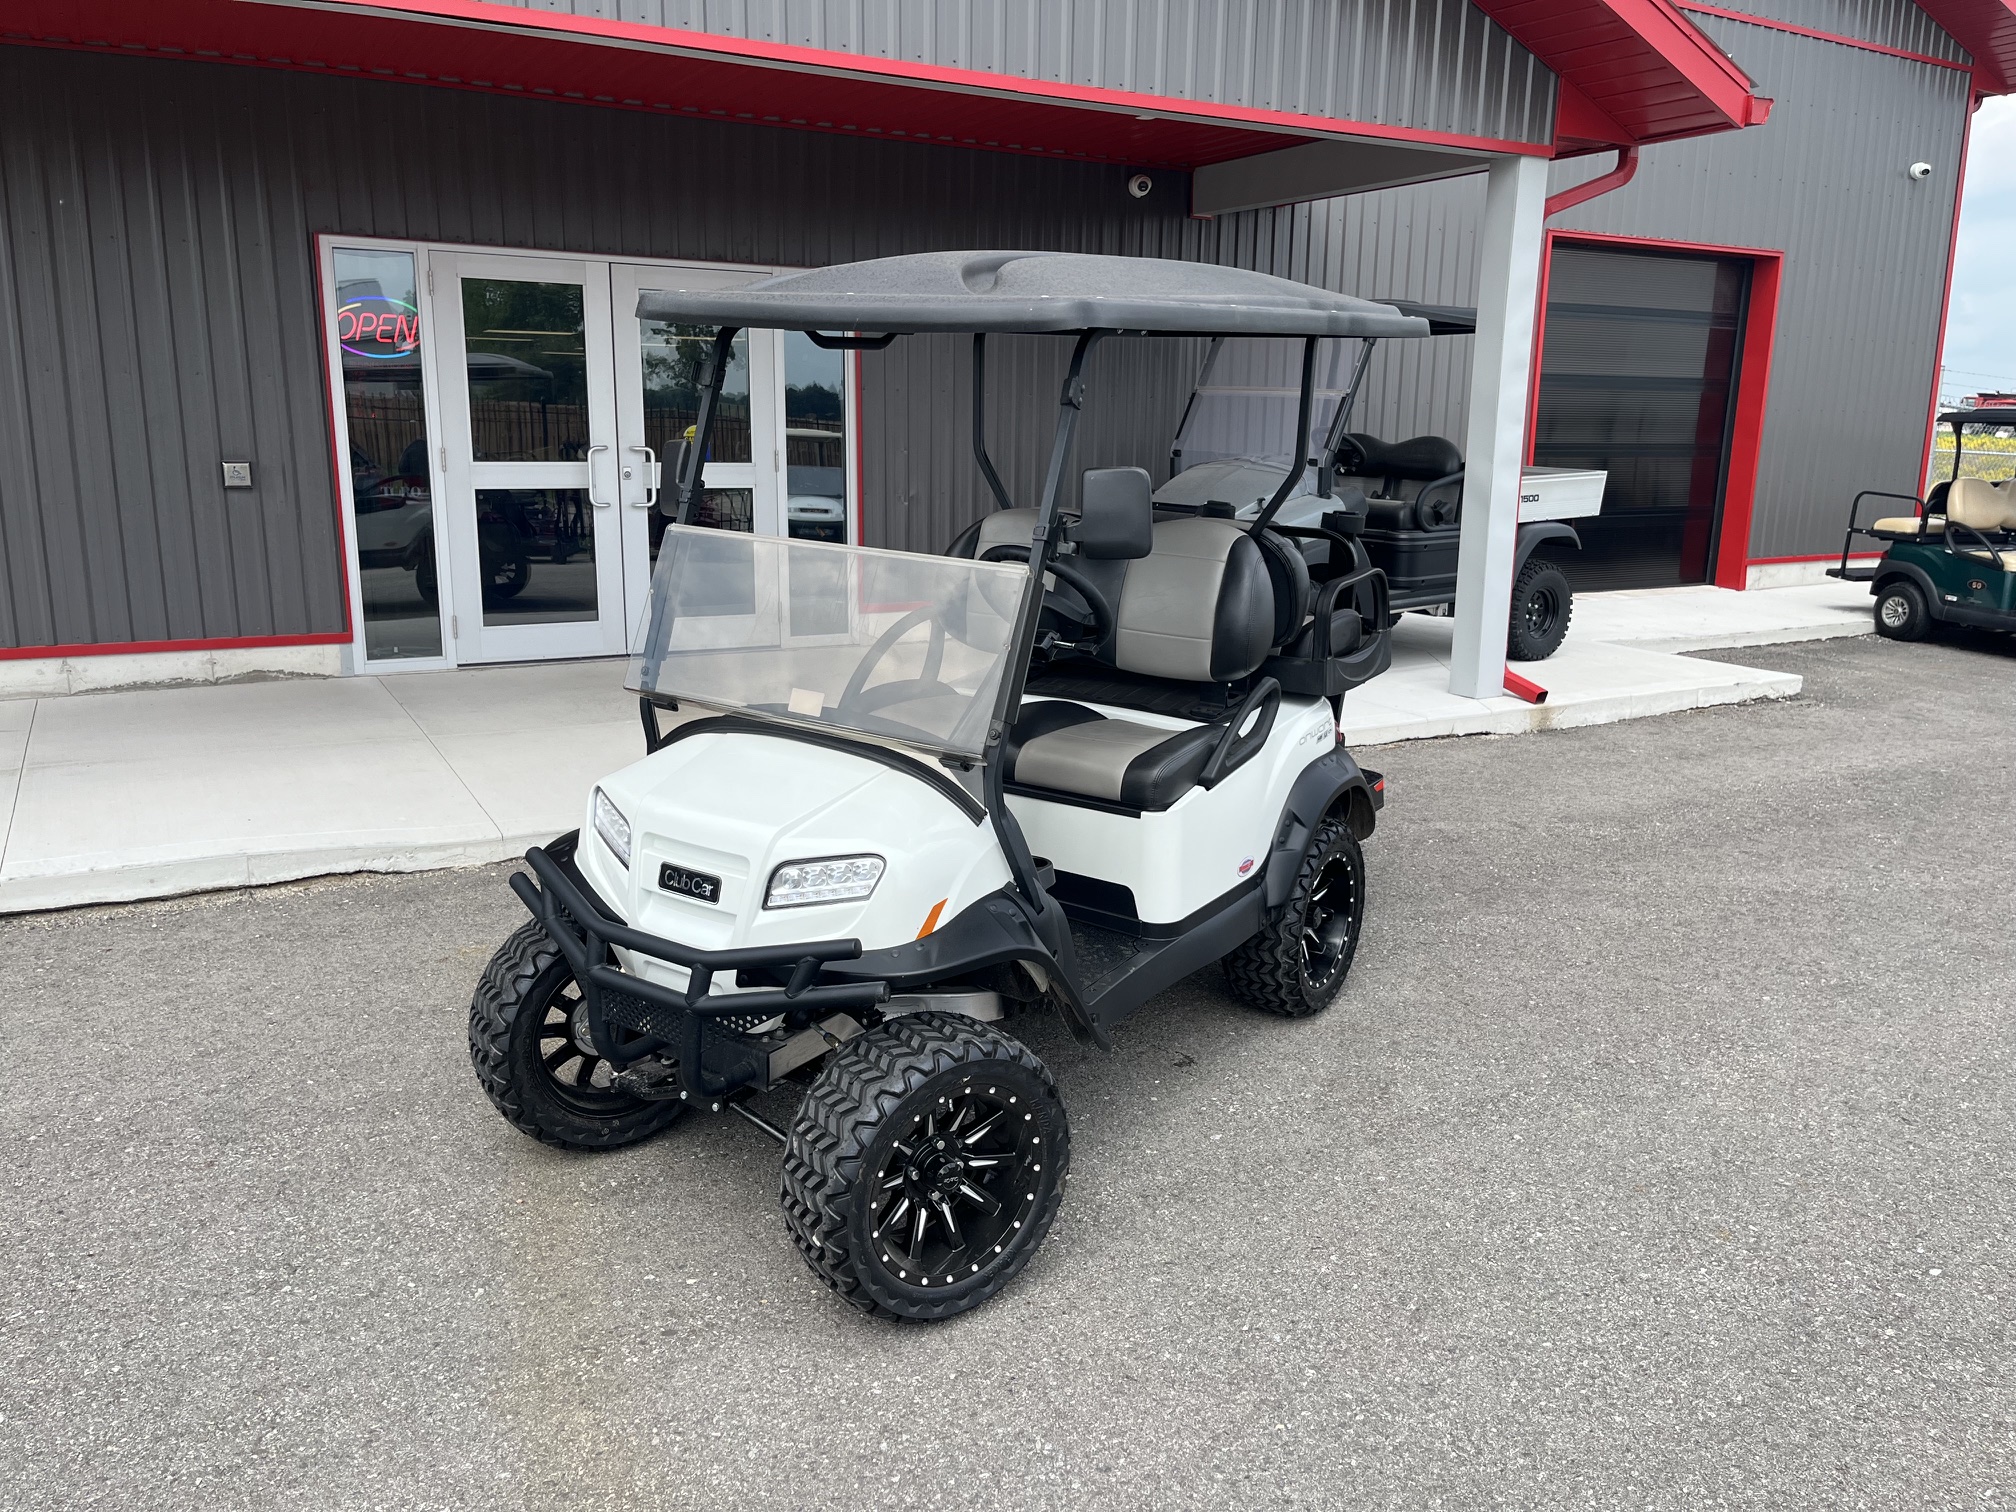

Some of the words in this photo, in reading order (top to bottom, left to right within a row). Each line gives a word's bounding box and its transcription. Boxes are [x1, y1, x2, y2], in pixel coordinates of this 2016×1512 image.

[338, 311, 418, 343] OPEN
[1521, 494, 1539, 503] 1500
[664, 869, 691, 891] Club
[691, 877, 714, 897] Car
